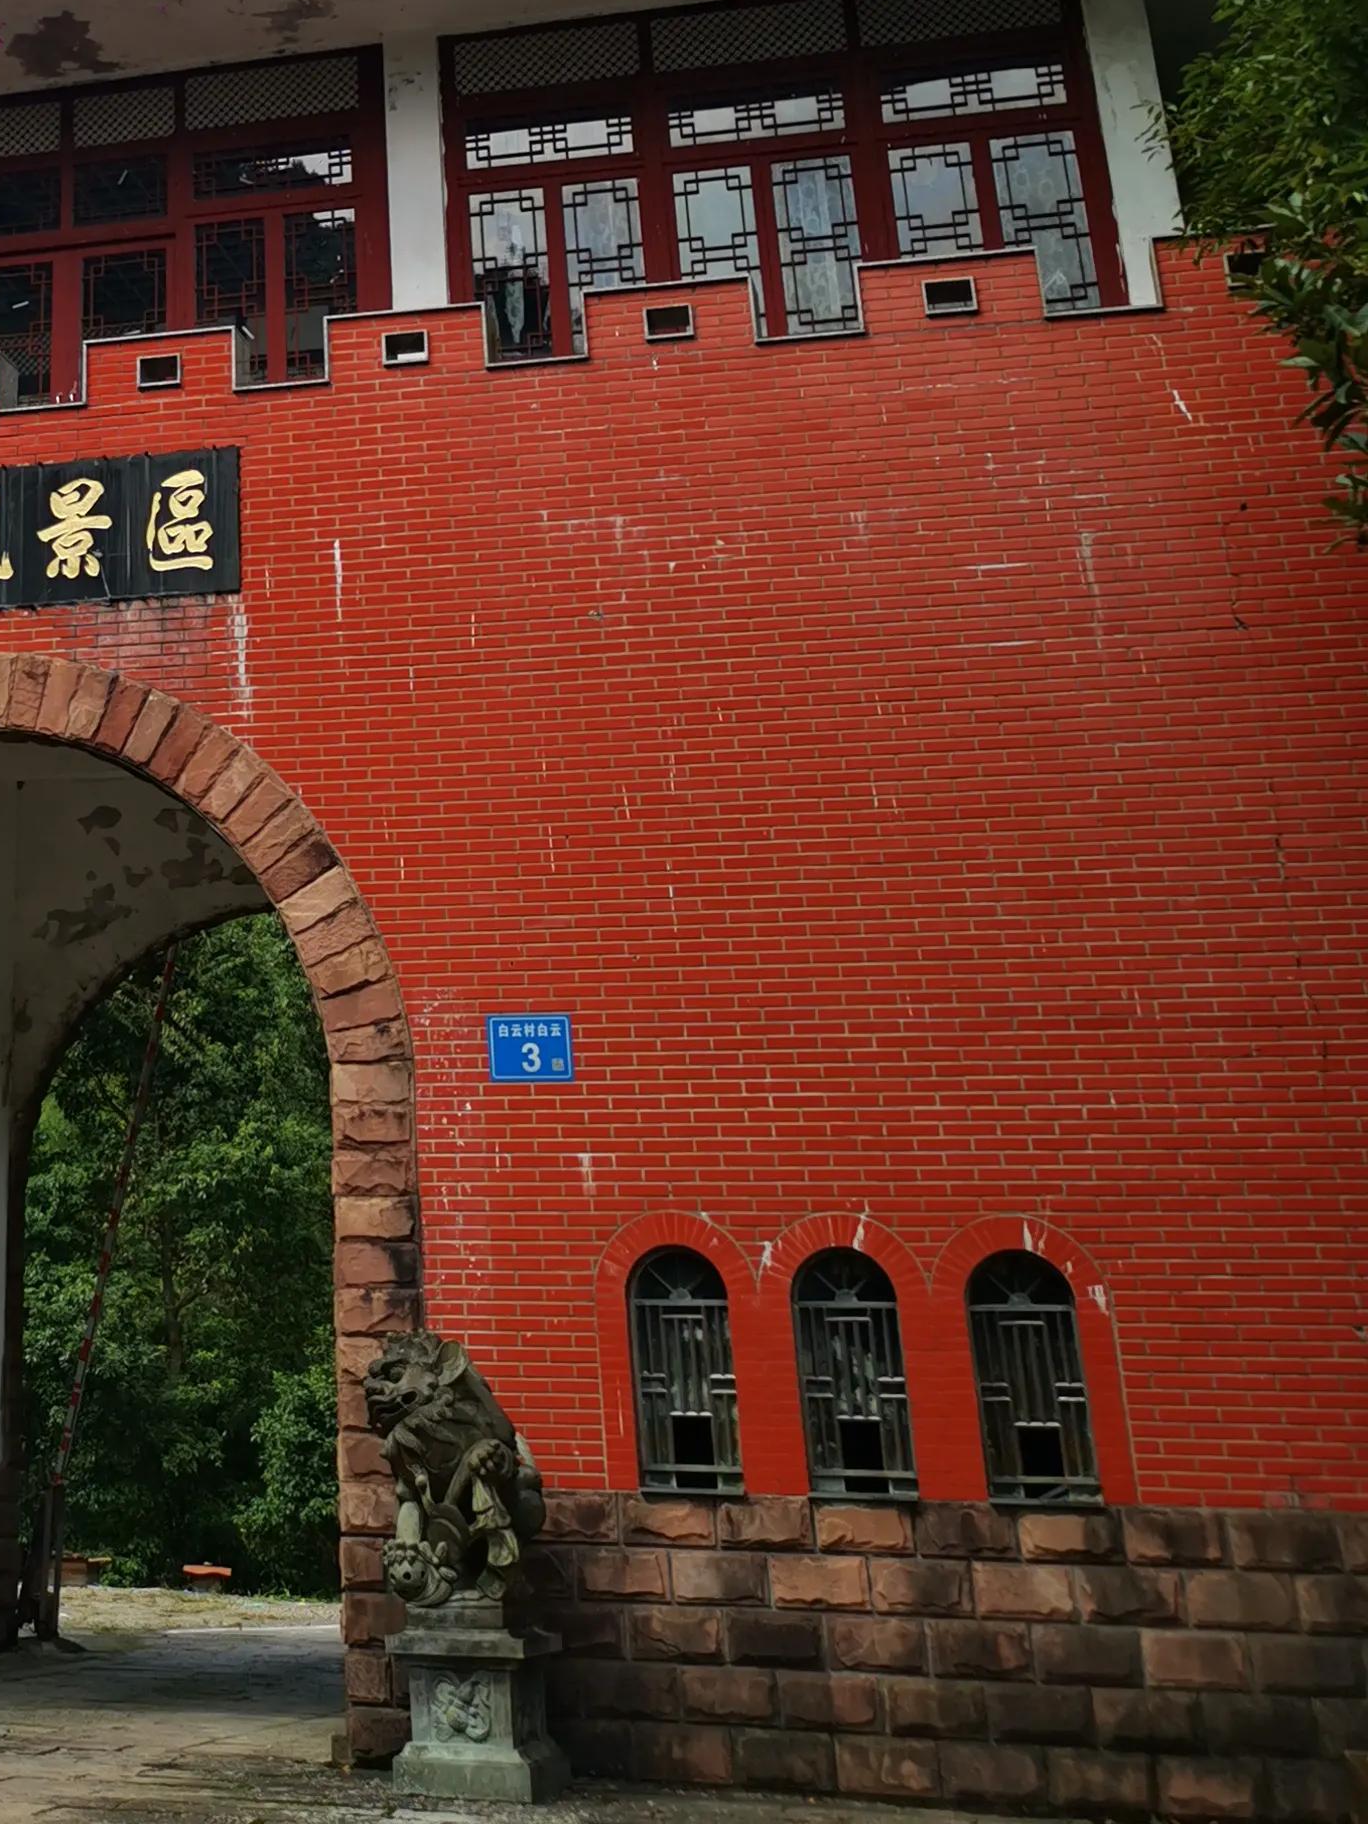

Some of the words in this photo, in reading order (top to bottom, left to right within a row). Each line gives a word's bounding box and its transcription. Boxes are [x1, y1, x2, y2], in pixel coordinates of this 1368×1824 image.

[498, 1022, 562, 1038] 白云村白云
[521, 1042, 542, 1073] 3
